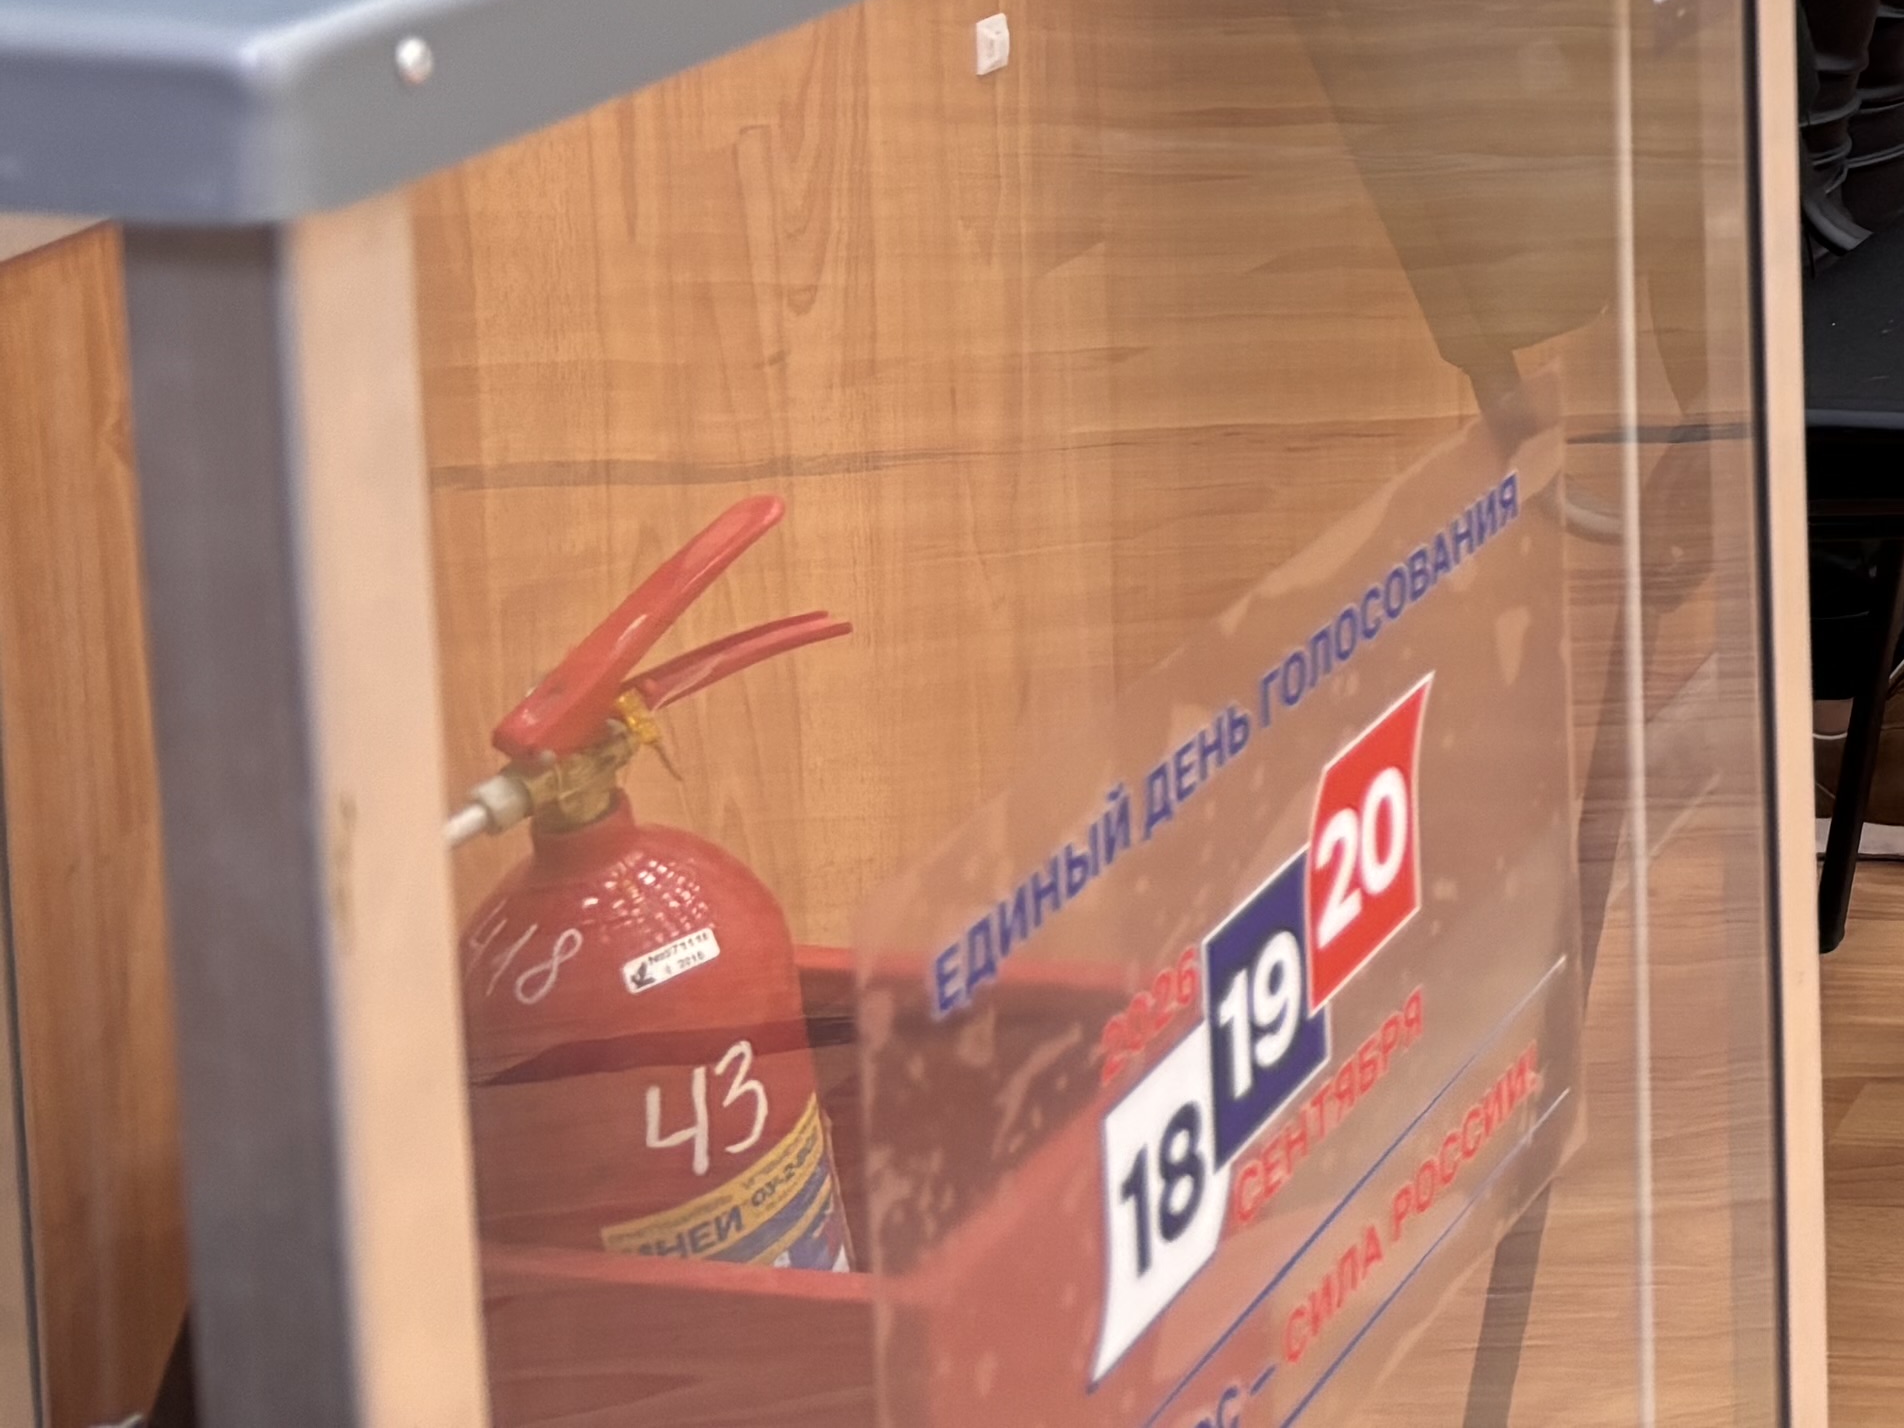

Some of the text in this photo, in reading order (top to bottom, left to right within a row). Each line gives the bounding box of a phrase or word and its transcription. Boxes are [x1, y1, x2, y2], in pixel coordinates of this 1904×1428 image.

[931, 470, 1520, 1021] ЕДИНЫЙ ДЕНЬ ГОЛОСОВАНИЯ
[1314, 766, 1409, 950] 20
[1101, 947, 1198, 1085] 2026
[1218, 930, 1301, 1101] 19
[645, 1040, 769, 1176] 43
[1119, 1100, 1206, 1278] 18
[1233, 986, 1425, 1225] СЕНТЯБРЯ
[1283, 1224, 1384, 1364] СИЛА
